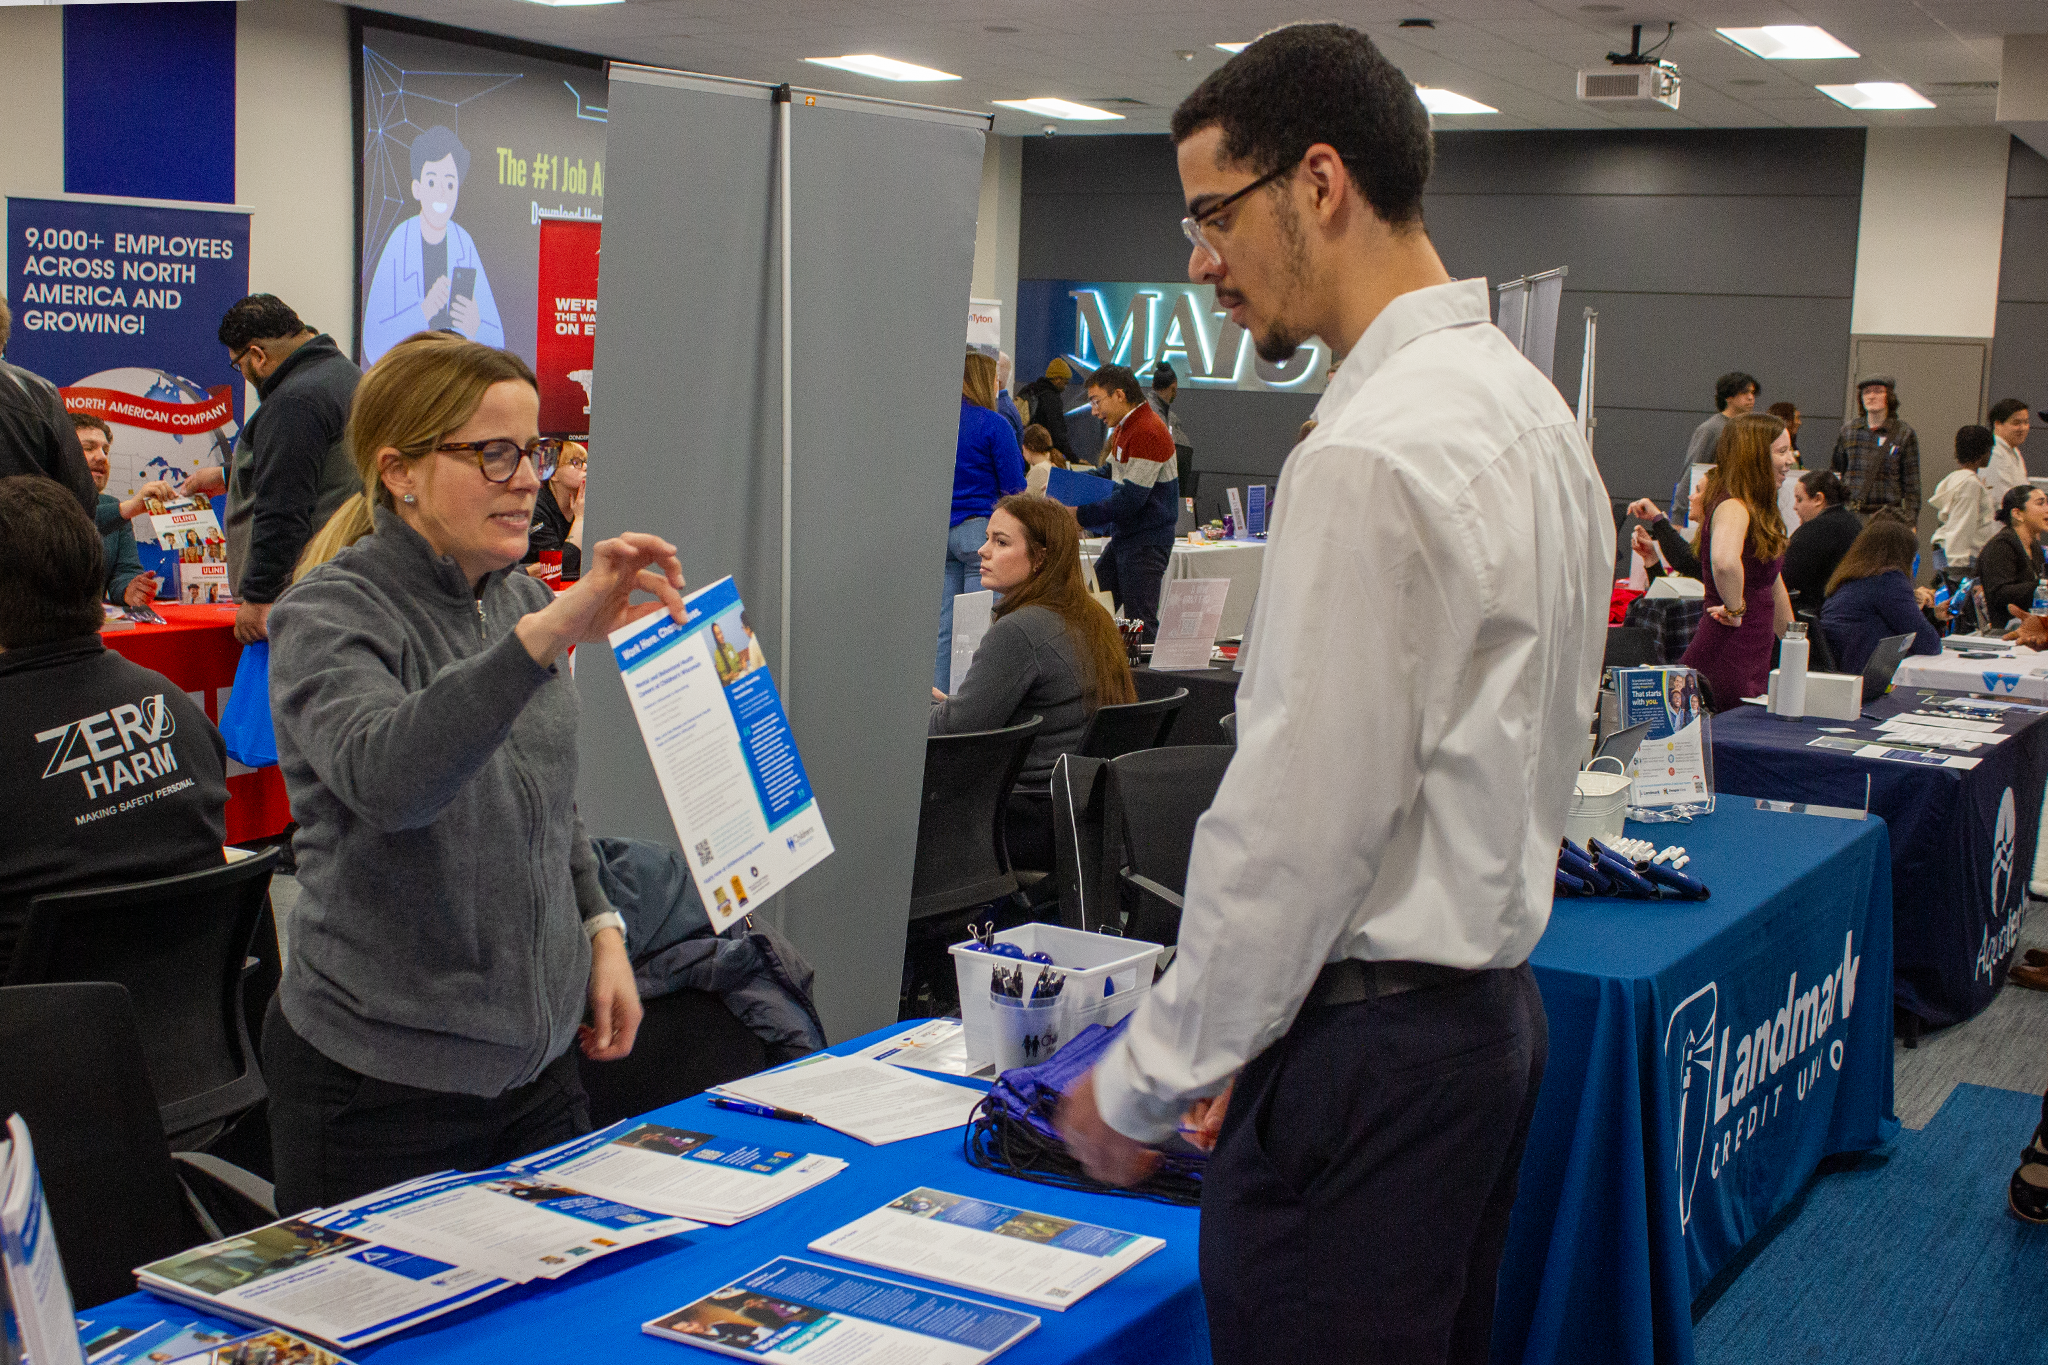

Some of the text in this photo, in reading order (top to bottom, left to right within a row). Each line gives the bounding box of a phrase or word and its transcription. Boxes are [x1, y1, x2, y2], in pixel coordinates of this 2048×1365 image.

[496, 147, 604, 197] The #1 Job A
[25, 227, 234, 260] 9,000+ EMPLOYEES
[23, 255, 196, 284] ACROSS NORTH
[22, 283, 182, 310] AMERICA AND
[23, 310, 146, 335] GROWING!
[555, 312, 577, 322] THE
[555, 322, 596, 336] ON E
[65, 397, 228, 426] NORTH AMERICAN COMPANY
[173, 514, 196, 523] ULINE
[203, 566, 224, 574] ULINE
[1632, 690, 1646, 698] That
[1645, 699, 1659, 707] you.
[81, 742, 179, 800] HARM
[74, 777, 196, 826] MAKING SAFETY PERSONAL
[1714, 929, 1860, 1126] Landmark
[1711, 1039, 1844, 1180] CREDIT UNIO
